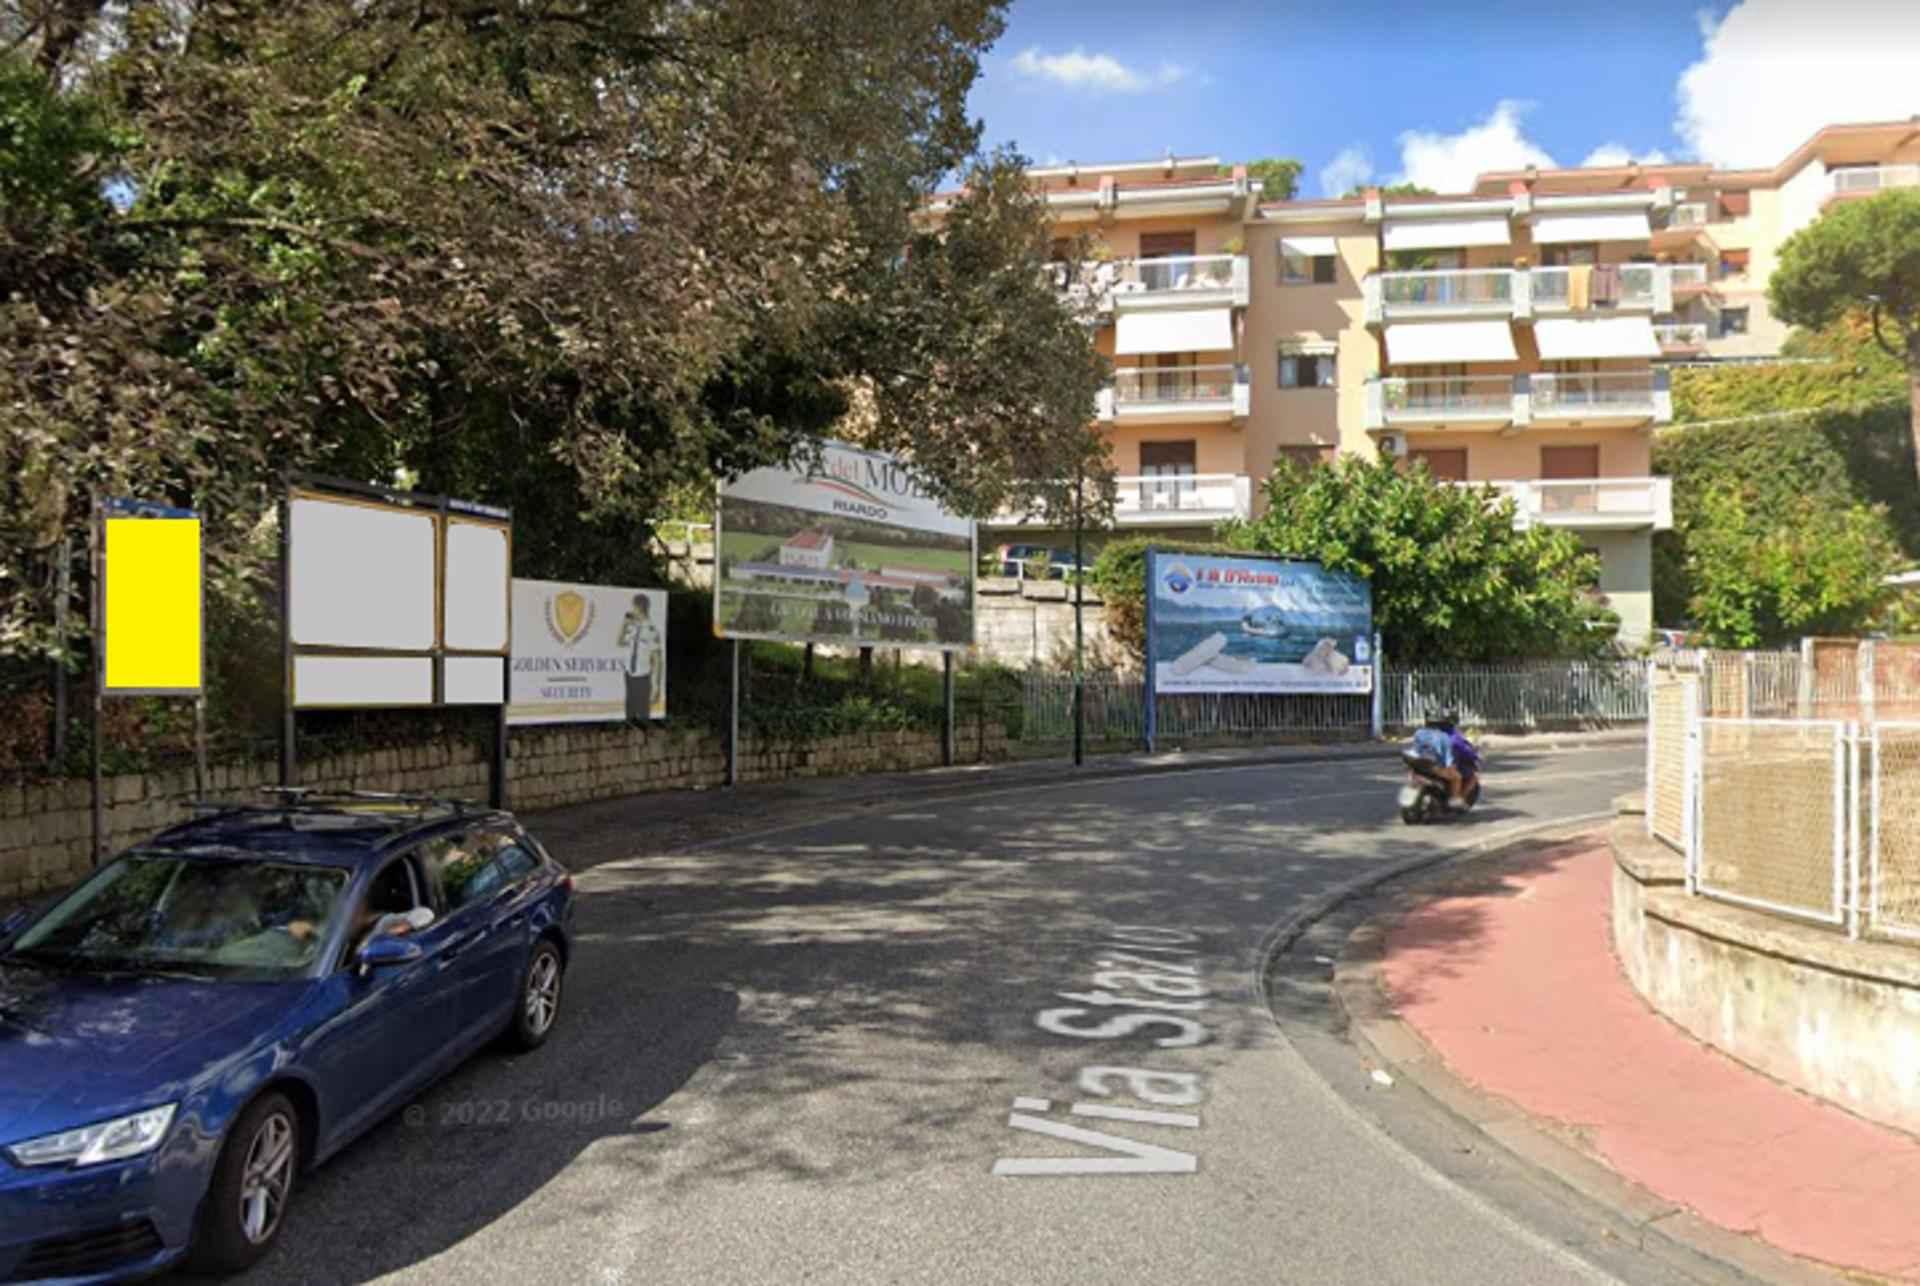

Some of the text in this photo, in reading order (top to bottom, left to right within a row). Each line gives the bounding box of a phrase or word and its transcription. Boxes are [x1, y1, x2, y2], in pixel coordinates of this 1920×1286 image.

[830, 457, 858, 481] del
[865, 459, 928, 499] MOL
[833, 499, 889, 520] RIARDO
[565, 657, 627, 673] SERVICES
[540, 685, 592, 700] SECURITY
